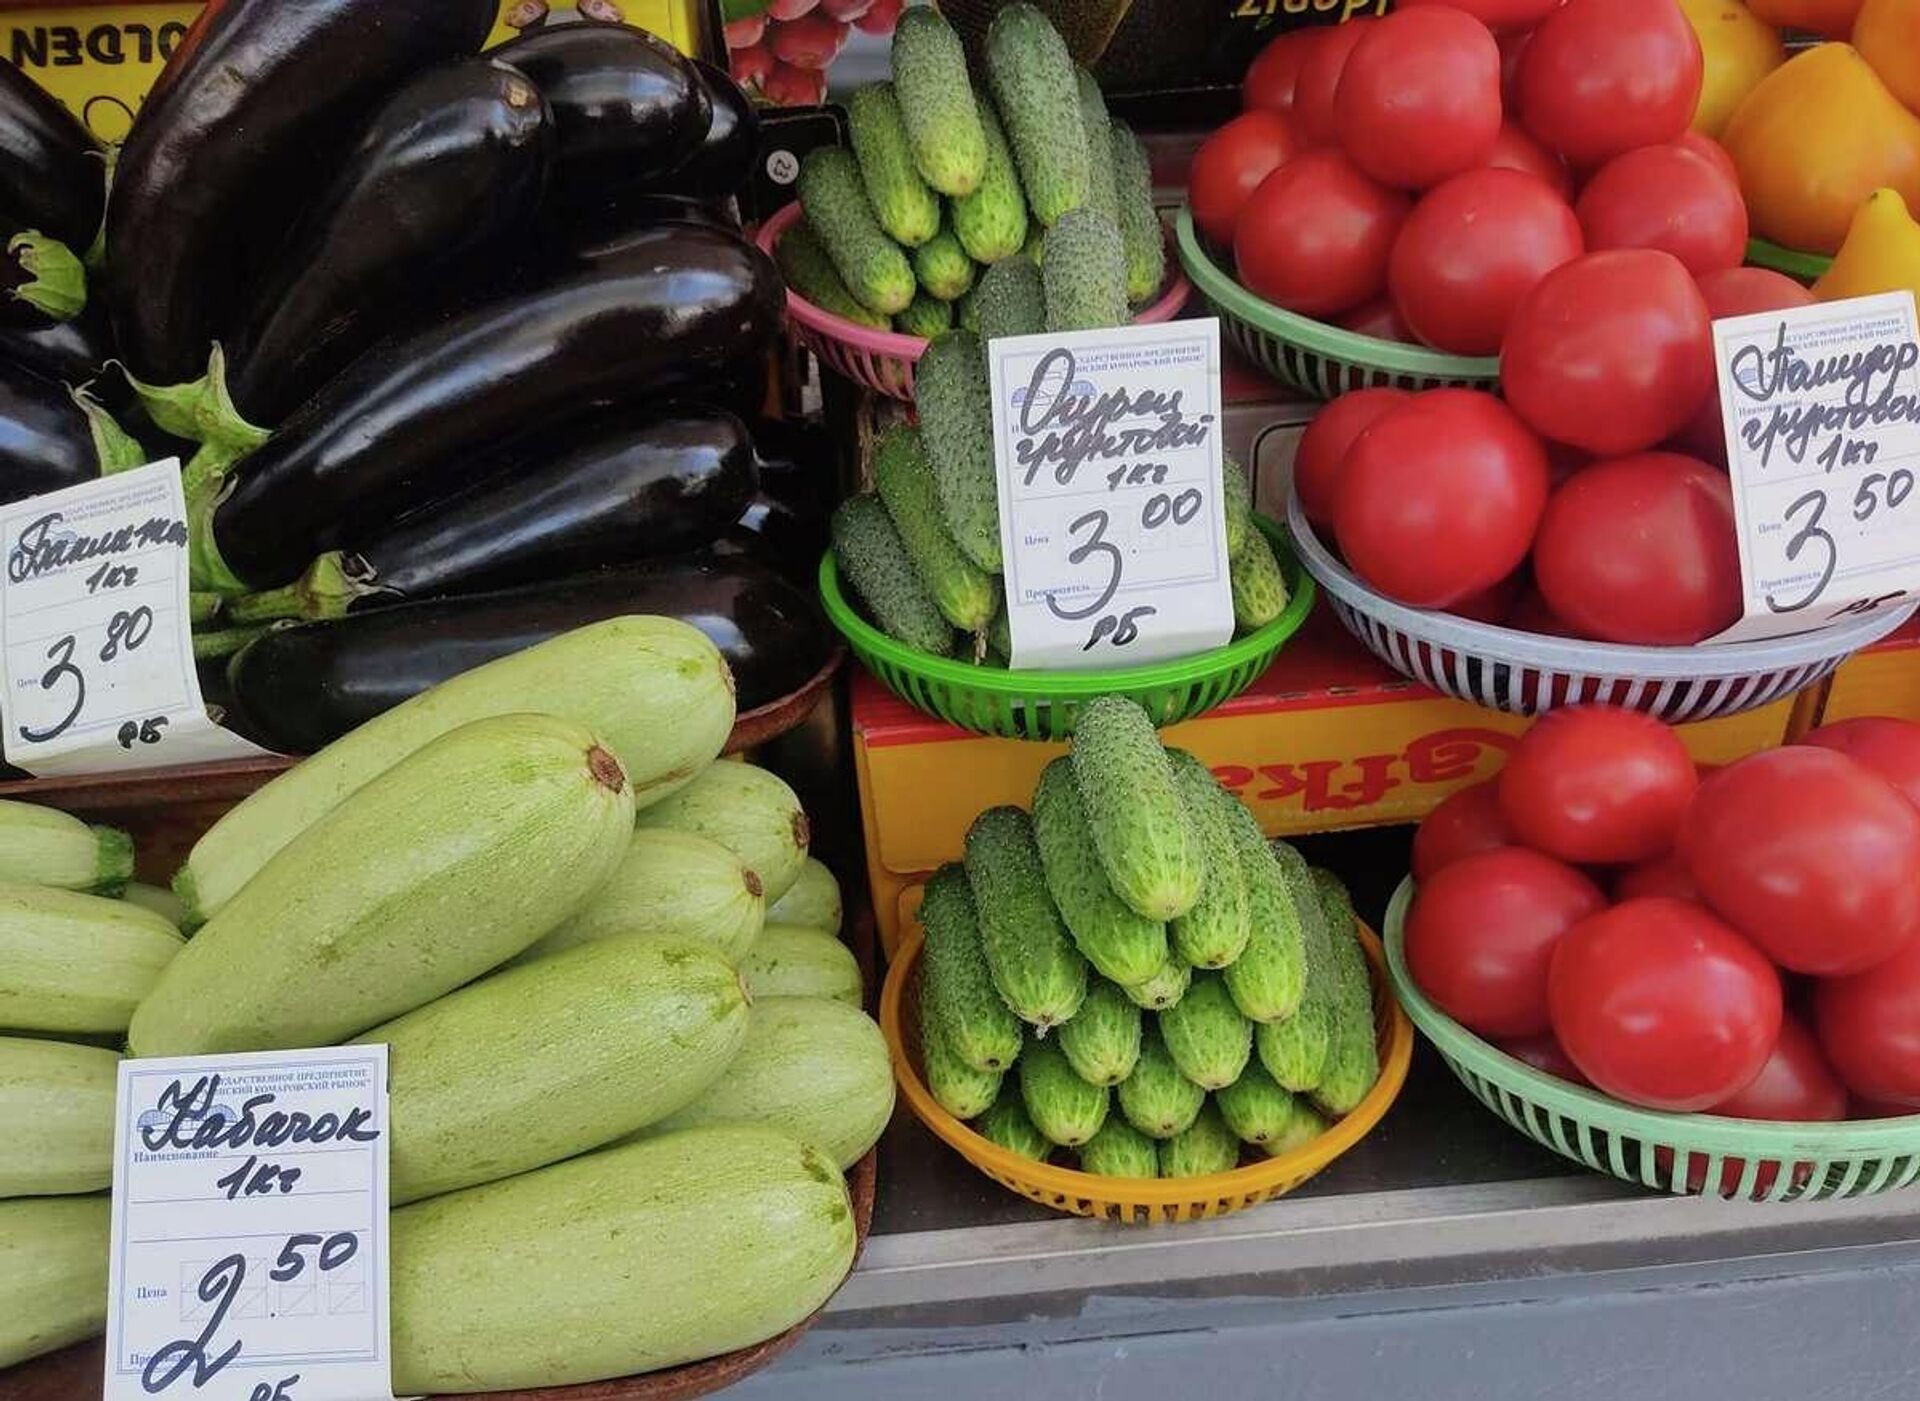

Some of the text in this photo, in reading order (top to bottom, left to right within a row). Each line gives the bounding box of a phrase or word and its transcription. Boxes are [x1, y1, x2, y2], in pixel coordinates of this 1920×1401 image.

[12, 22, 187, 68] OLDEN
[1047, 488, 1202, 620] 3 00
[1766, 469, 1914, 613] 3 50
[19, 605, 153, 743] 3 80
[219, 1073, 293, 1087] УДАРСТВЕННОЕ
[136, 1286, 168, 1300] Цена
[142, 1232, 358, 1394] 2 50
